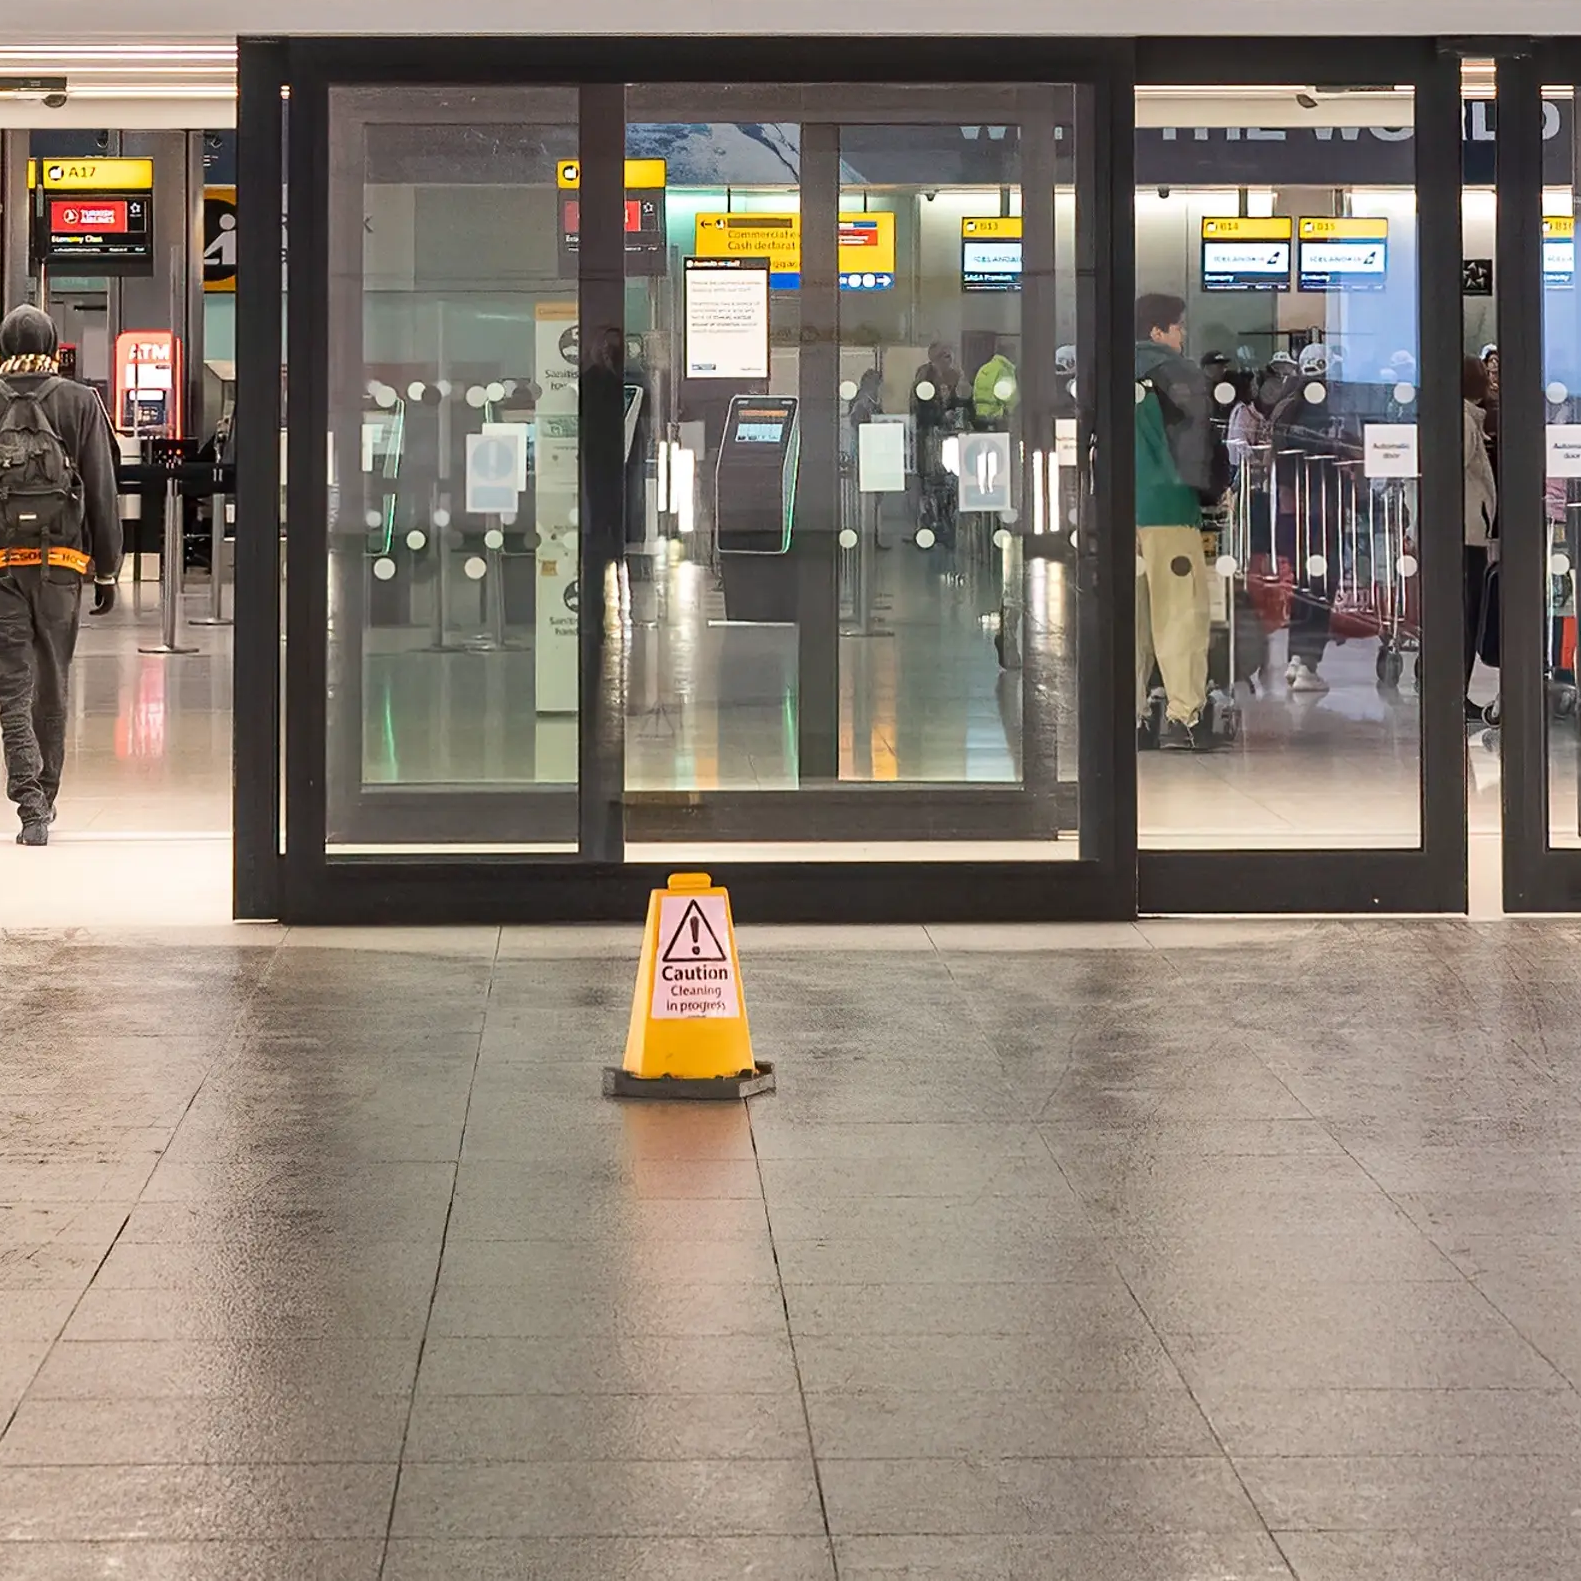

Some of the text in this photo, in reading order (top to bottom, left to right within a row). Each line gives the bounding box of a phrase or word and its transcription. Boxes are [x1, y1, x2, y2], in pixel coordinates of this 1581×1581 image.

[68, 166, 97, 178] A17
[128, 343, 170, 360] ATM
[661, 964, 729, 982] Caution
[670, 984, 722, 998] Cleaning
[680, 1000, 726, 1014] progress
